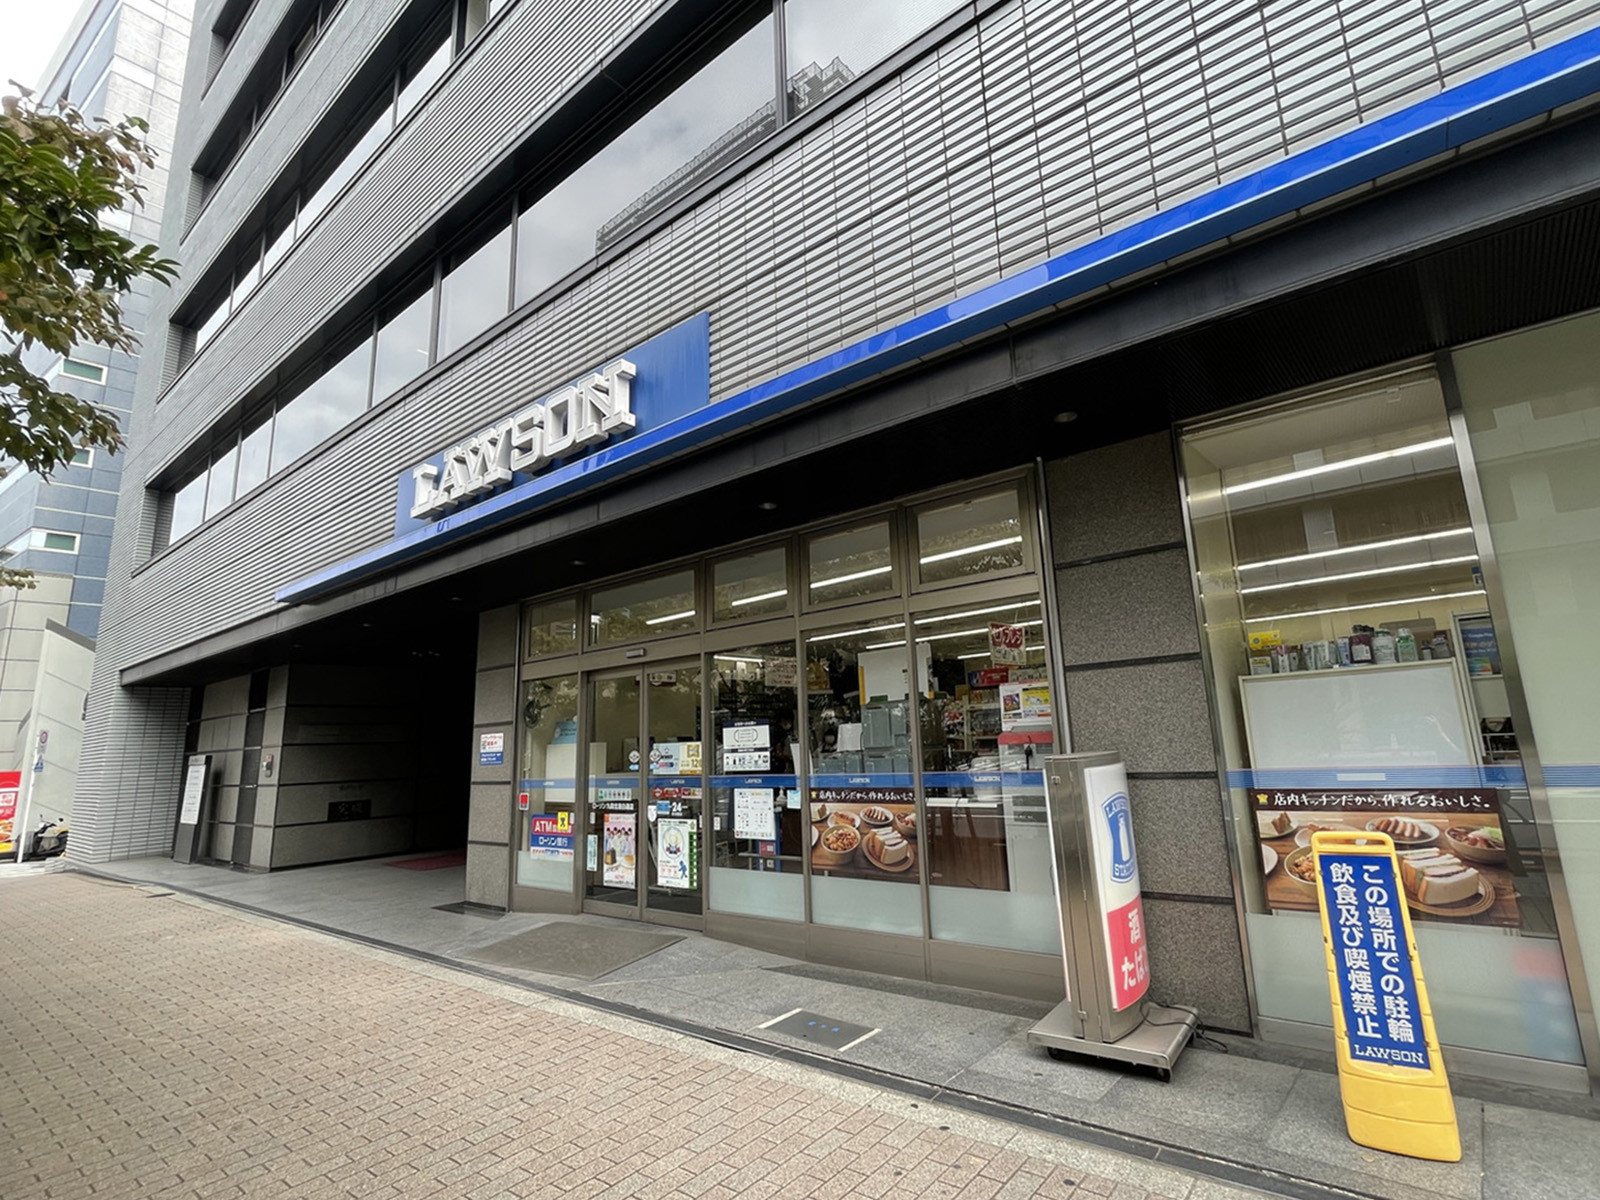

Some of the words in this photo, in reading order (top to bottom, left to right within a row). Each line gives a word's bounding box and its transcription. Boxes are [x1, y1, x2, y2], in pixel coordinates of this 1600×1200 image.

[410, 358, 637, 520] LAWSON
[534, 820, 553, 833] ATM
[1329, 862, 1382, 1040] 飲食及び喫煙禁止
[1362, 864, 1415, 1044] この場所での駐輪
[1354, 1043, 1424, 1065] LAWSON
